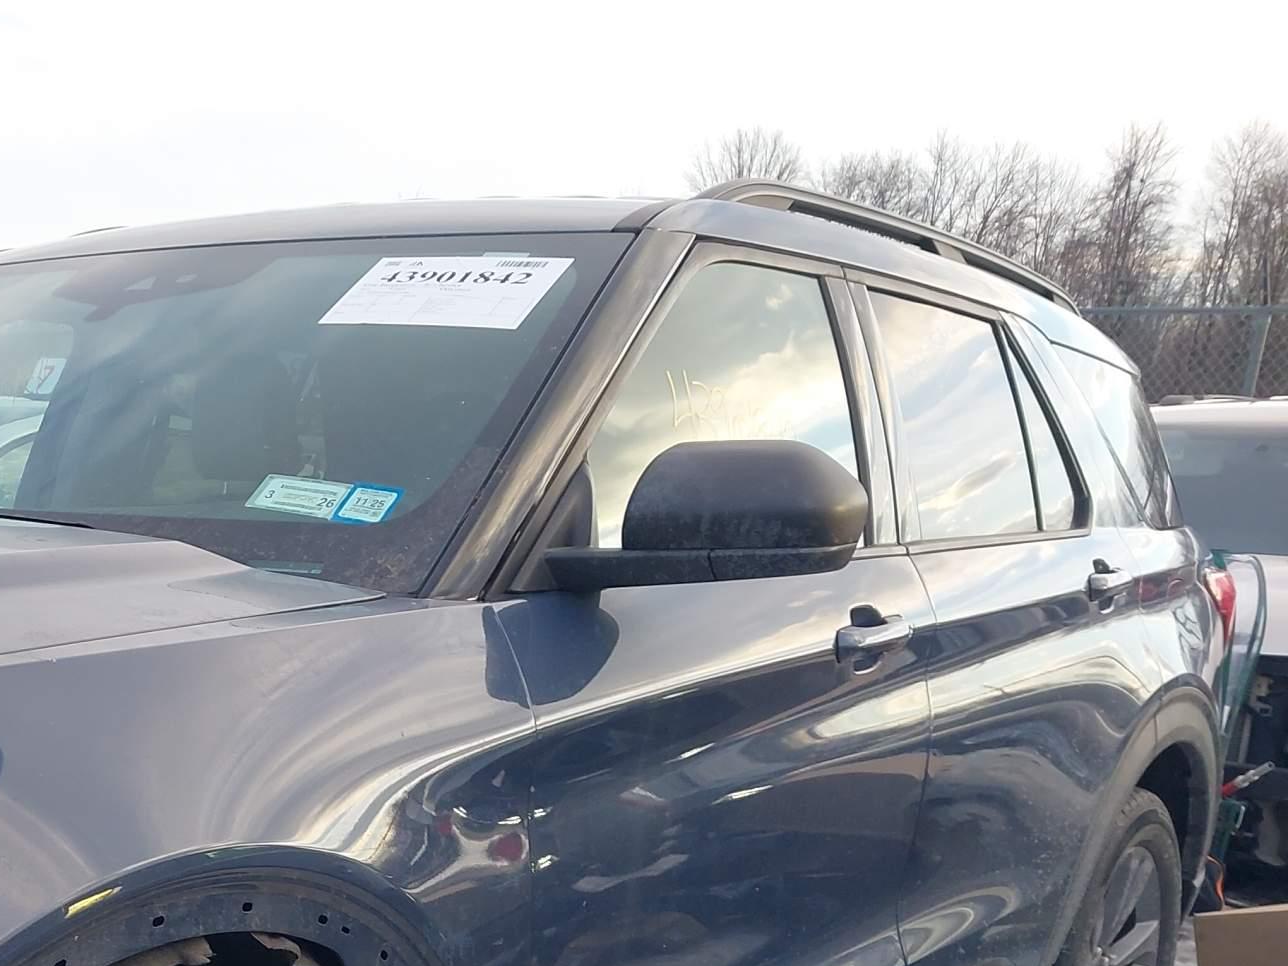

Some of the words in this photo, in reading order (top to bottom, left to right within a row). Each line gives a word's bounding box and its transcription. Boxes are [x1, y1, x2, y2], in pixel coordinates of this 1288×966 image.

[381, 271, 532, 285] 43901842
[265, 489, 275, 499] 3
[317, 497, 336, 508] 26
